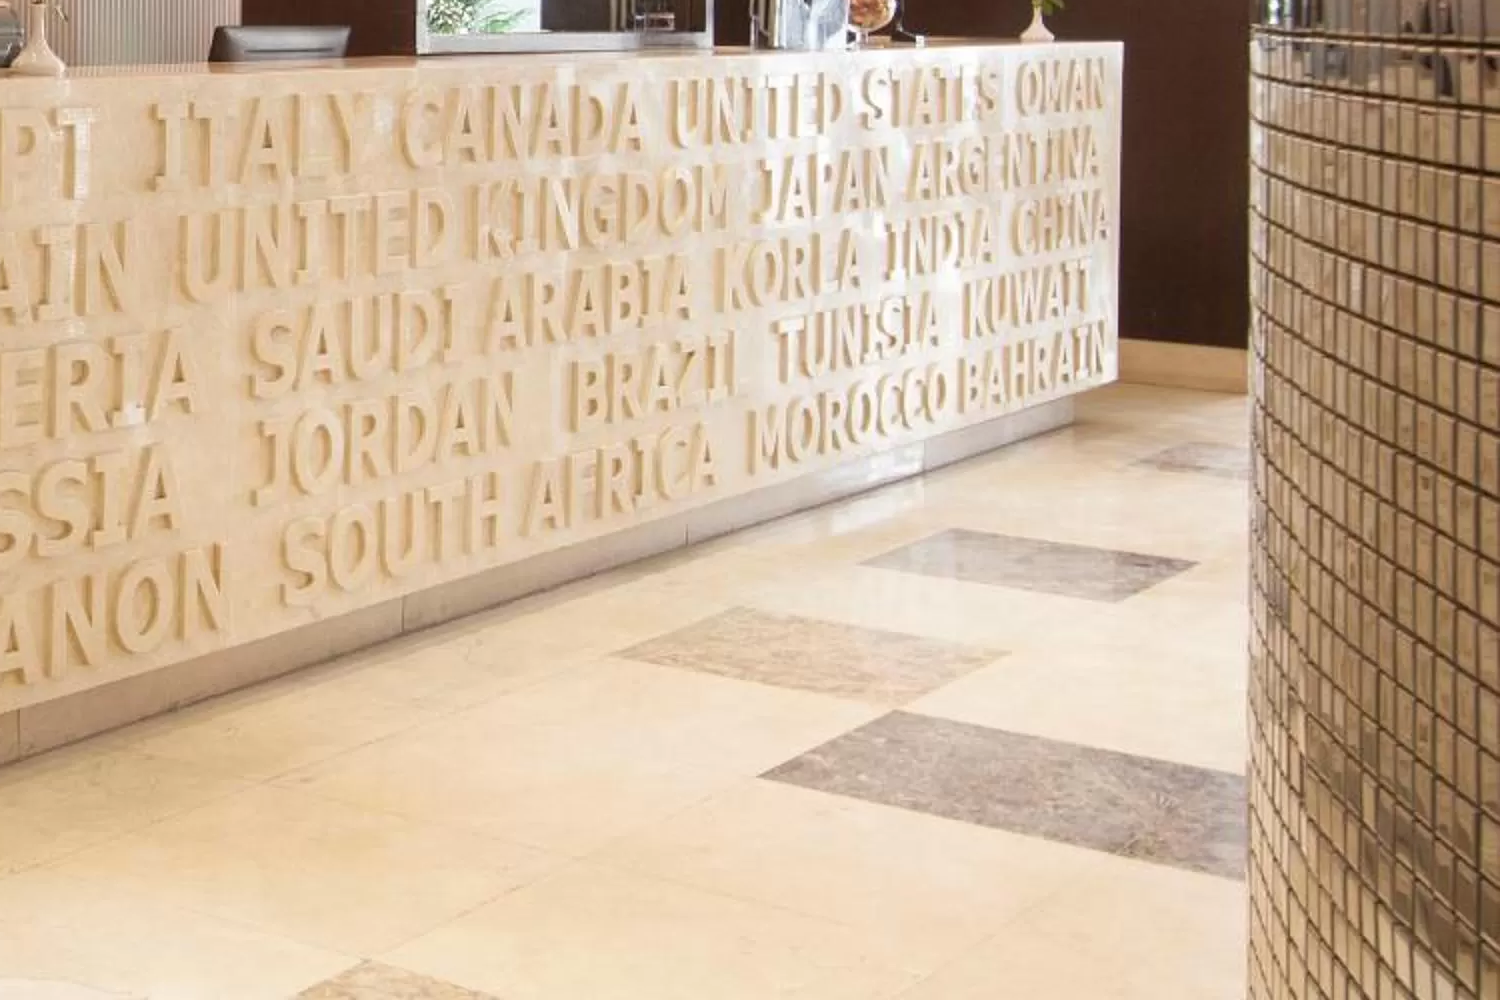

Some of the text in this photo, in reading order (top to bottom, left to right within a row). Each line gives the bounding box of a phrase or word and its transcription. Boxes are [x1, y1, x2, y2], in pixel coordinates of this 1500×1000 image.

[150, 91, 371, 191] ITALY
[402, 83, 645, 171] CANADA
[667, 70, 844, 149] UNITED
[861, 64, 998, 131] STATES
[1017, 57, 1106, 117] OMAN
[177, 188, 452, 302] UNITED
[470, 163, 729, 262] KINGDOM
[748, 145, 888, 223] JAPAN
[248, 285, 456, 398] SAUDI
[484, 253, 692, 356] ARABIA
[884, 208, 993, 282] INDIA
[1011, 188, 1108, 257] CHINA
[250, 371, 514, 504] JORDAN
[773, 291, 940, 383] TUNISIA
[962, 257, 1091, 340] KUWAIT
[279, 471, 499, 607] SOUTH
[520, 421, 715, 538] AFRICA
[746, 362, 947, 475] MOROCCO
[957, 320, 1106, 415] BAHRAIN
